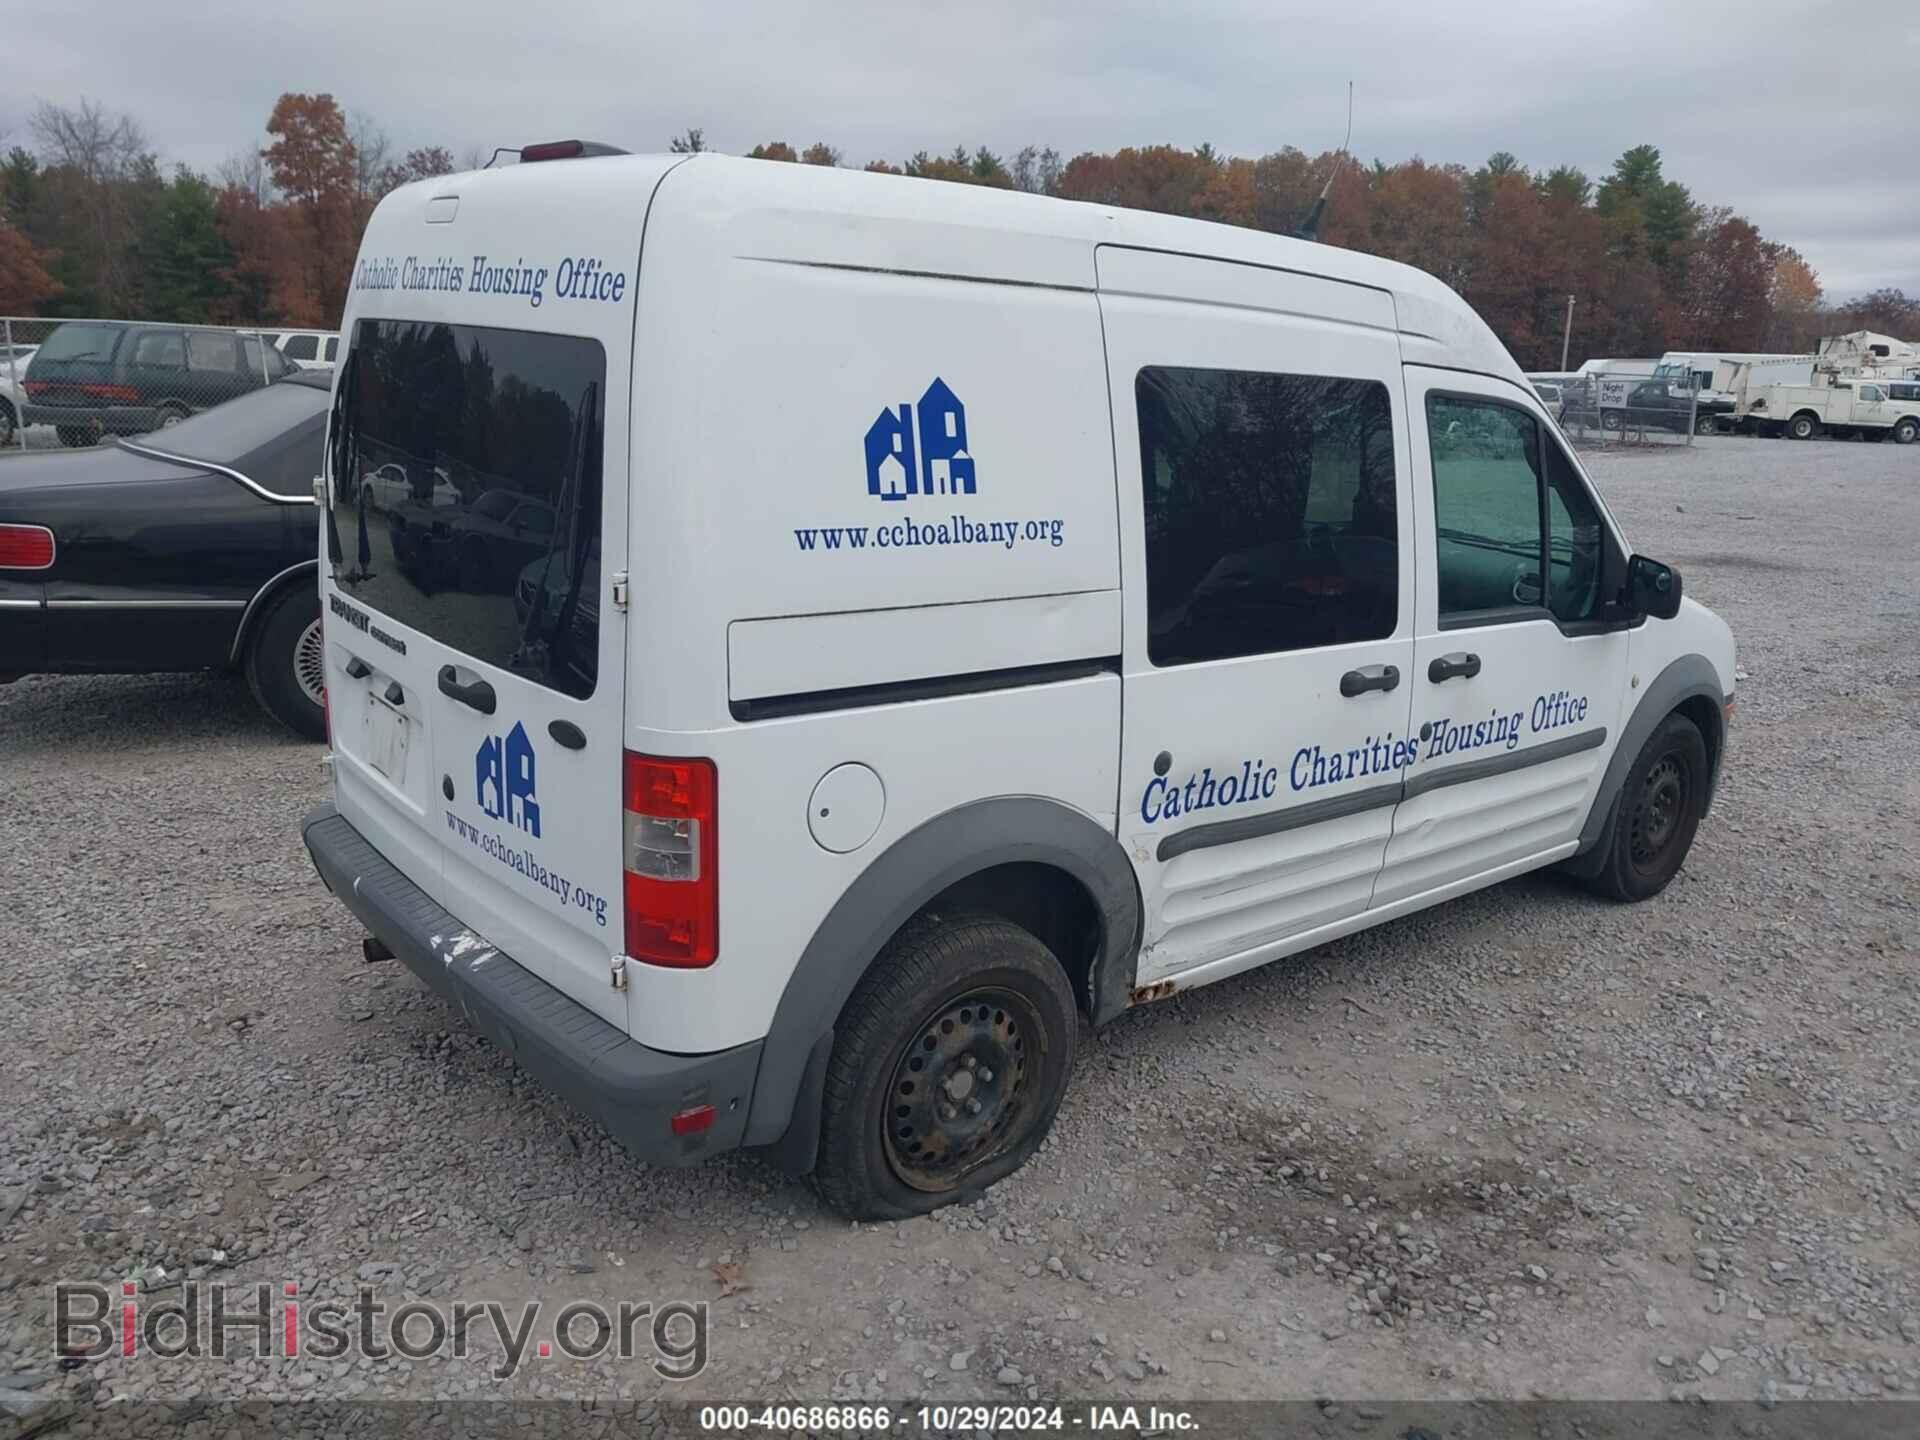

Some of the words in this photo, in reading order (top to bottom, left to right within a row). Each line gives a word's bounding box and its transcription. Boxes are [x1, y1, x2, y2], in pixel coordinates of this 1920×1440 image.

[355, 257, 399, 290] Catholic
[401, 256, 464, 292] Charities
[469, 256, 548, 307] Housing
[556, 257, 626, 302] Office
[1602, 393, 1621, 404] Drop
[1603, 383, 1624, 393] Night
[794, 516, 1064, 550] www.cchoalbany.org
[1140, 759, 1277, 824] Catholic
[1290, 732, 1419, 791] Charities
[1425, 711, 1525, 760] Housing
[1531, 693, 1588, 733] Office
[446, 811, 607, 927] www.cchoalbany.org
